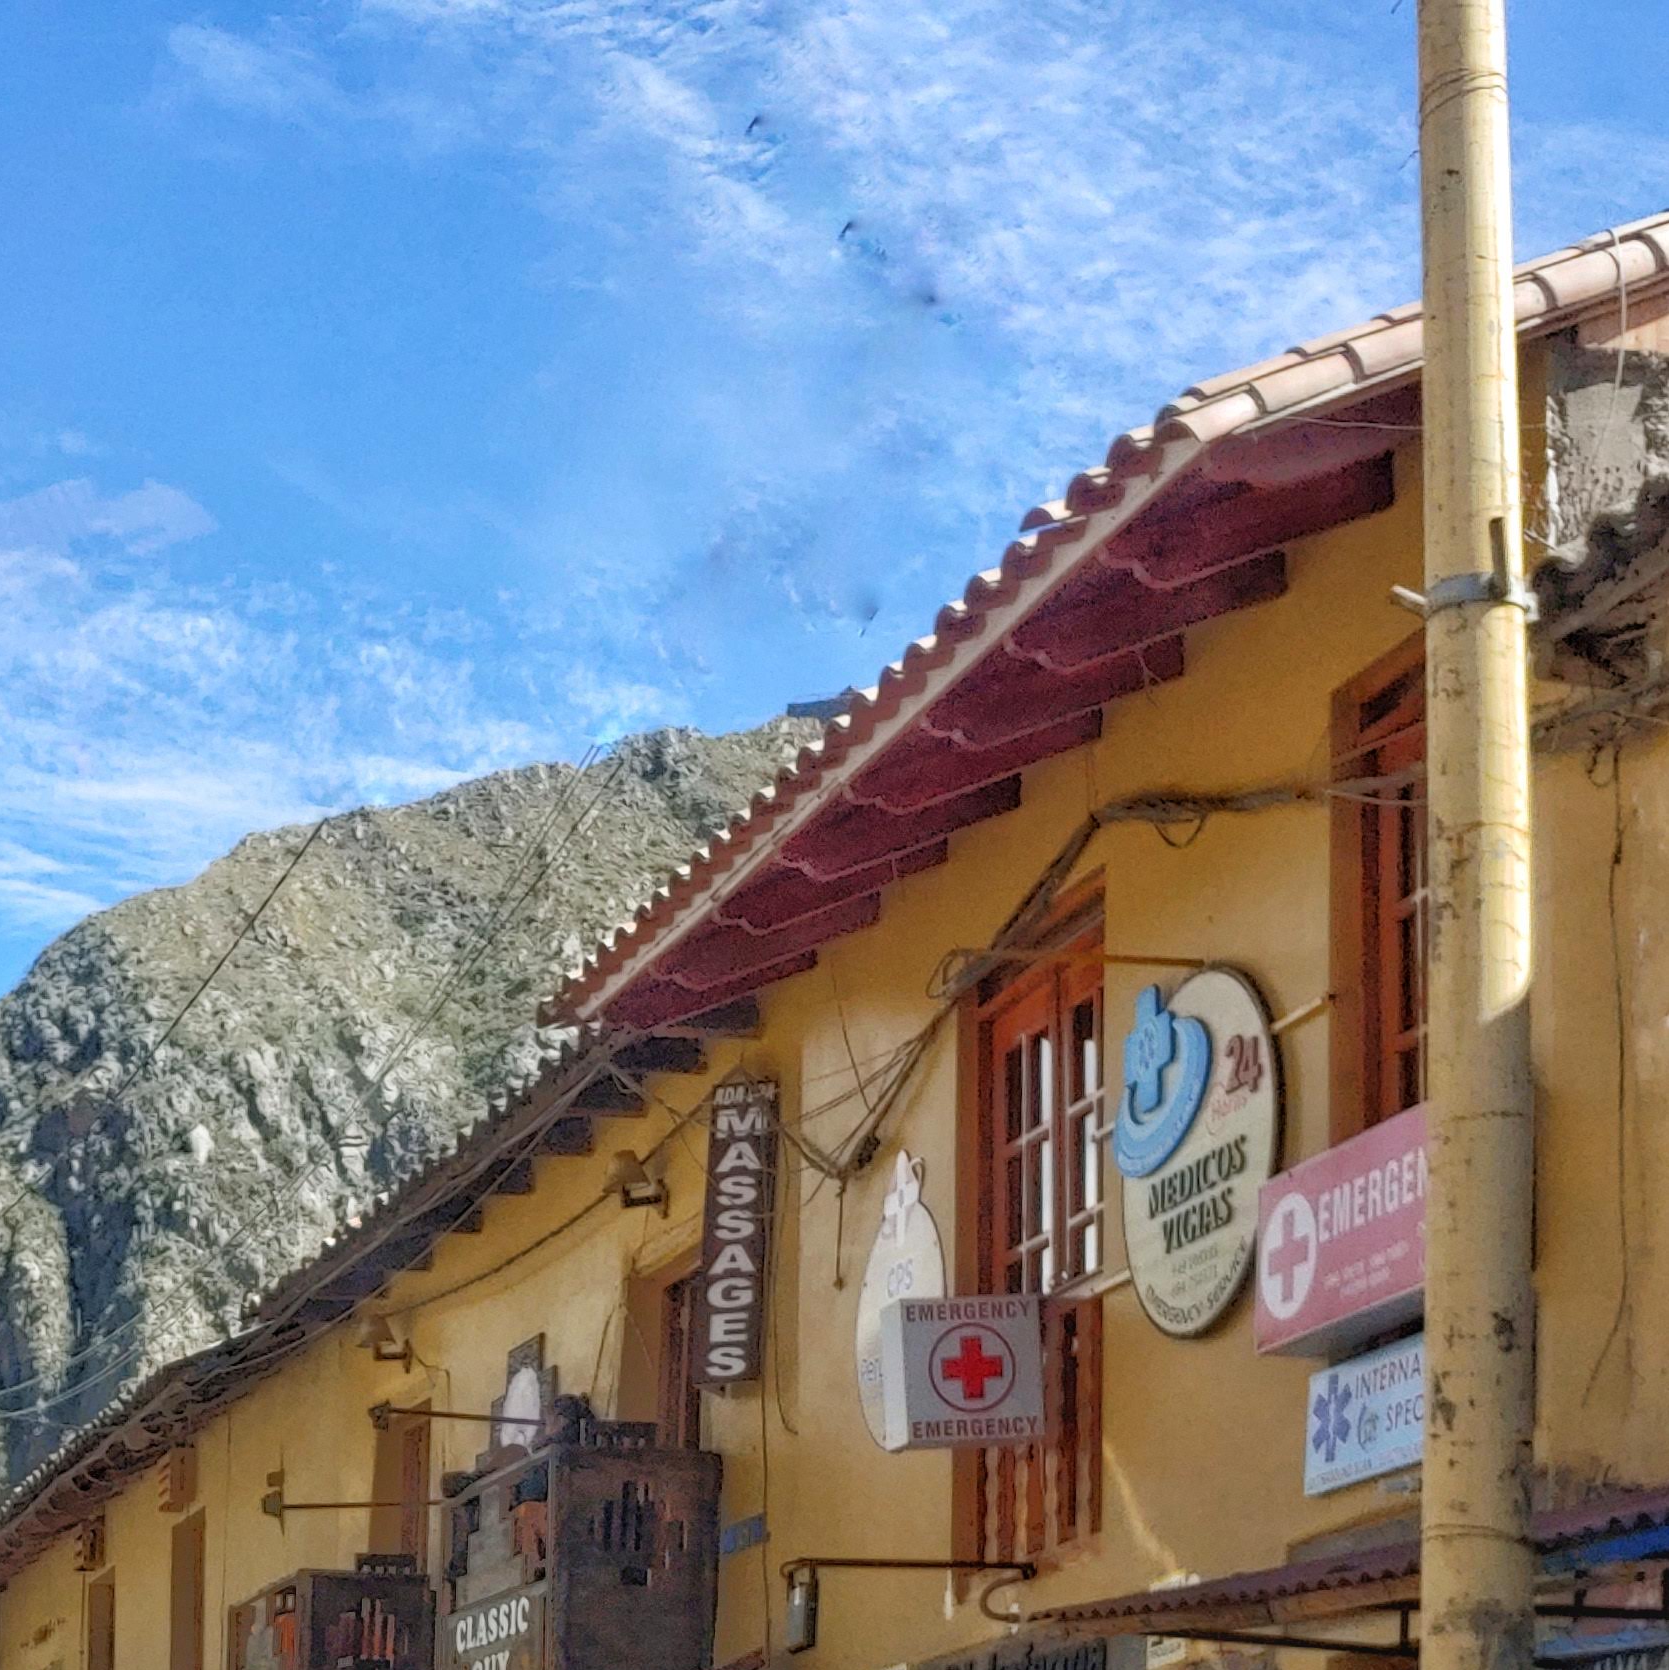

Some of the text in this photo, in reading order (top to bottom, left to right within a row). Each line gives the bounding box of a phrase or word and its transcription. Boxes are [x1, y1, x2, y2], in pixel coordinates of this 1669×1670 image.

[1226, 1035, 1263, 1094] 24
[1149, 1134, 1247, 1220] MEDICOS
[705, 1107, 764, 1377] MASSAGES
[906, 1302, 1031, 1324] EMERGENCY
[912, 1415, 1038, 1440] EMERGENCY
[456, 1596, 529, 1655] CLASSIC
